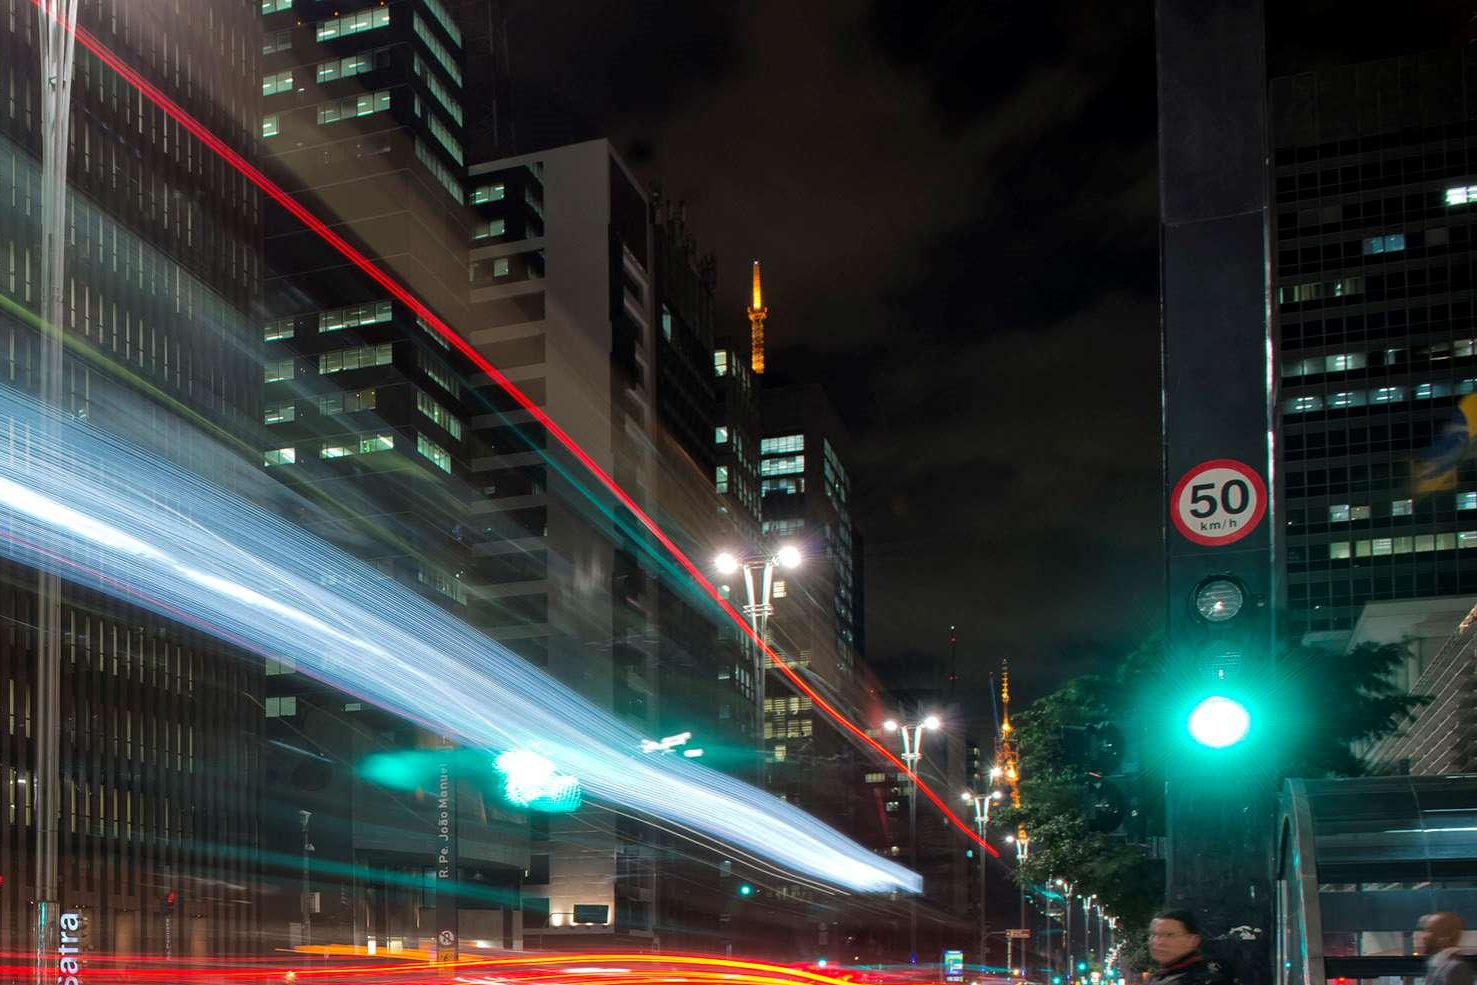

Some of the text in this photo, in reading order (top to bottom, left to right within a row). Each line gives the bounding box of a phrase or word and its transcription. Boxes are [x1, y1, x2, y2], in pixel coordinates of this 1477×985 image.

[1190, 479, 1249, 519] 50
[1200, 519, 1237, 531] km/h
[439, 763, 448, 808] Manuel
[439, 811, 449, 842] João
[439, 866, 449, 879] R.
